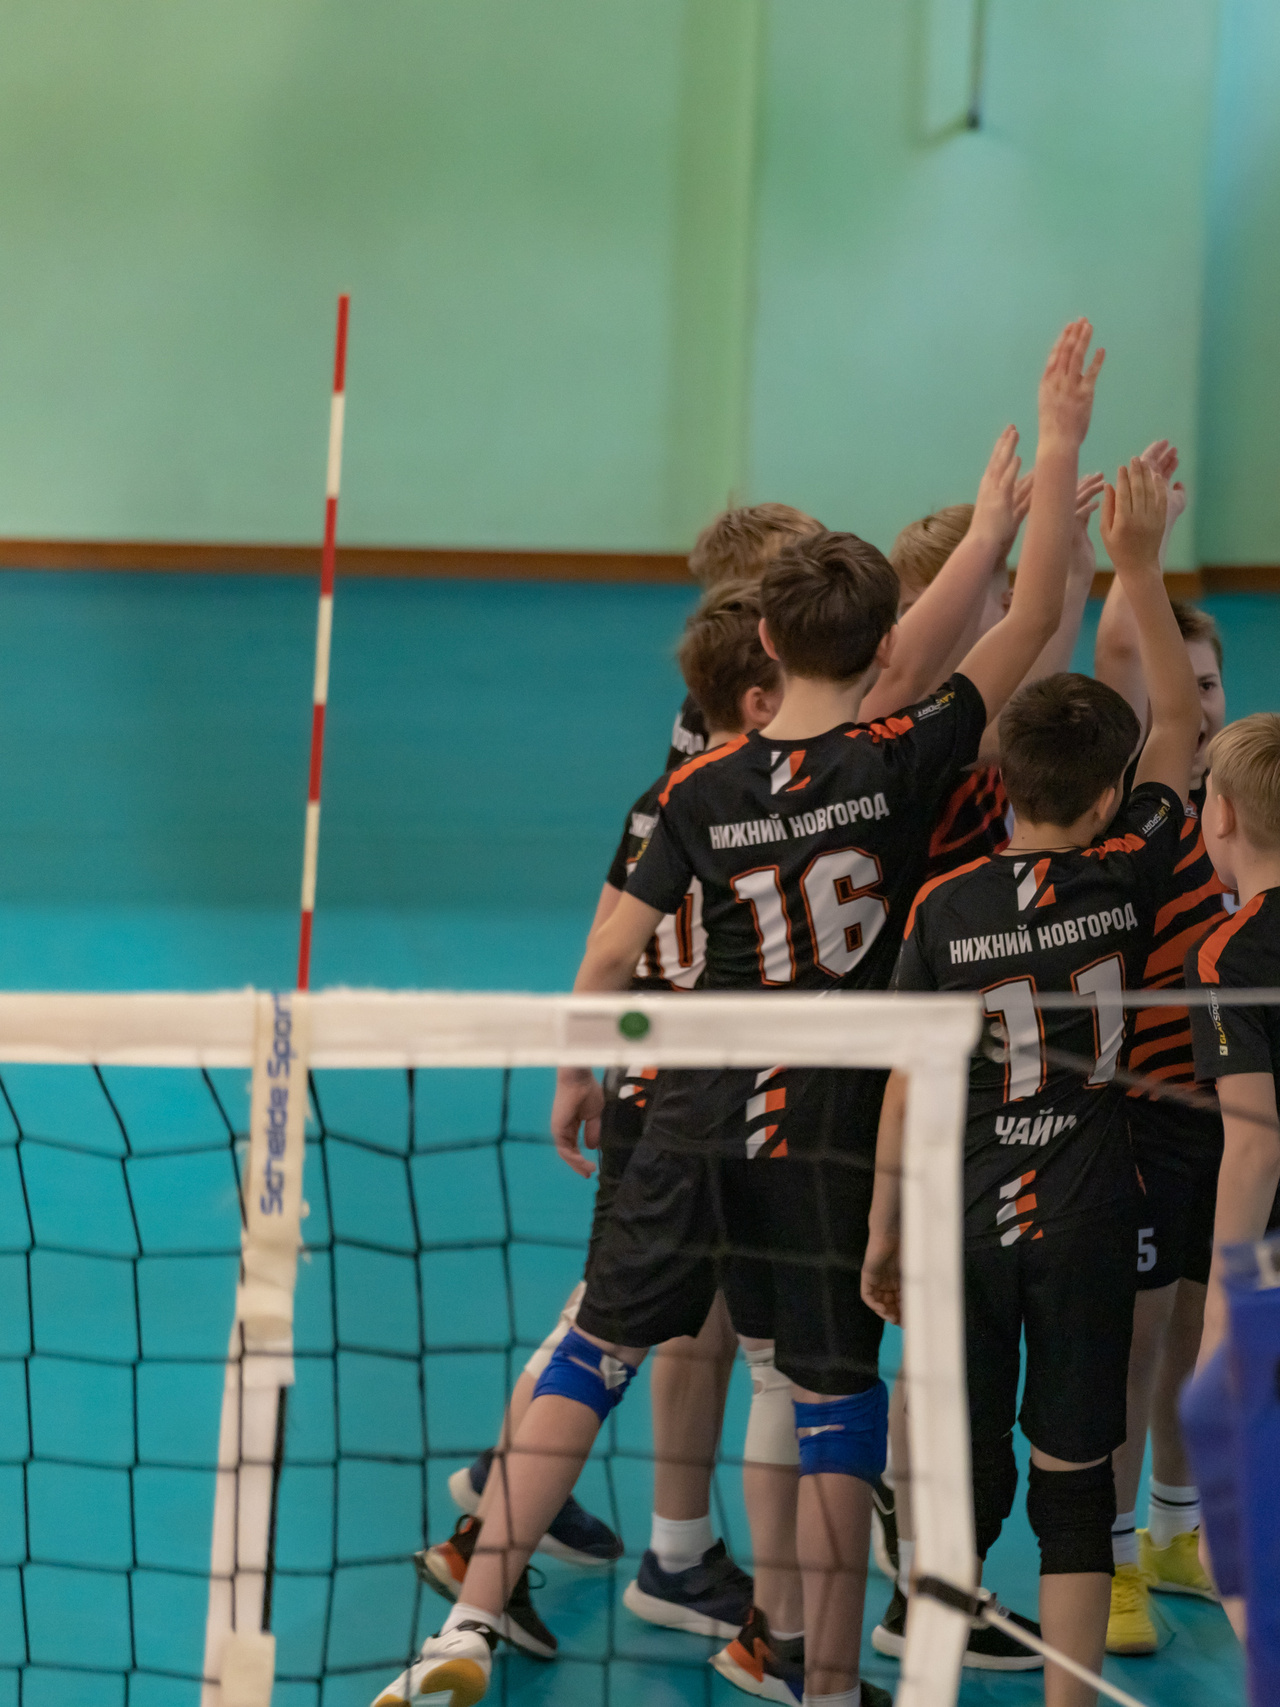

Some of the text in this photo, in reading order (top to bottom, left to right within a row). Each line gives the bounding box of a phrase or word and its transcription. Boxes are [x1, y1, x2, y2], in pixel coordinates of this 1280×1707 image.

[709, 813, 788, 849] НИЖНИЙ
[788, 792, 890, 838] НОВГОРОД
[730, 846, 889, 986] 16
[949, 902, 1138, 964] НИЖНИЙ НОВГОРОД
[979, 951, 1127, 1104] 11
[1136, 1227, 1158, 1273] 5
